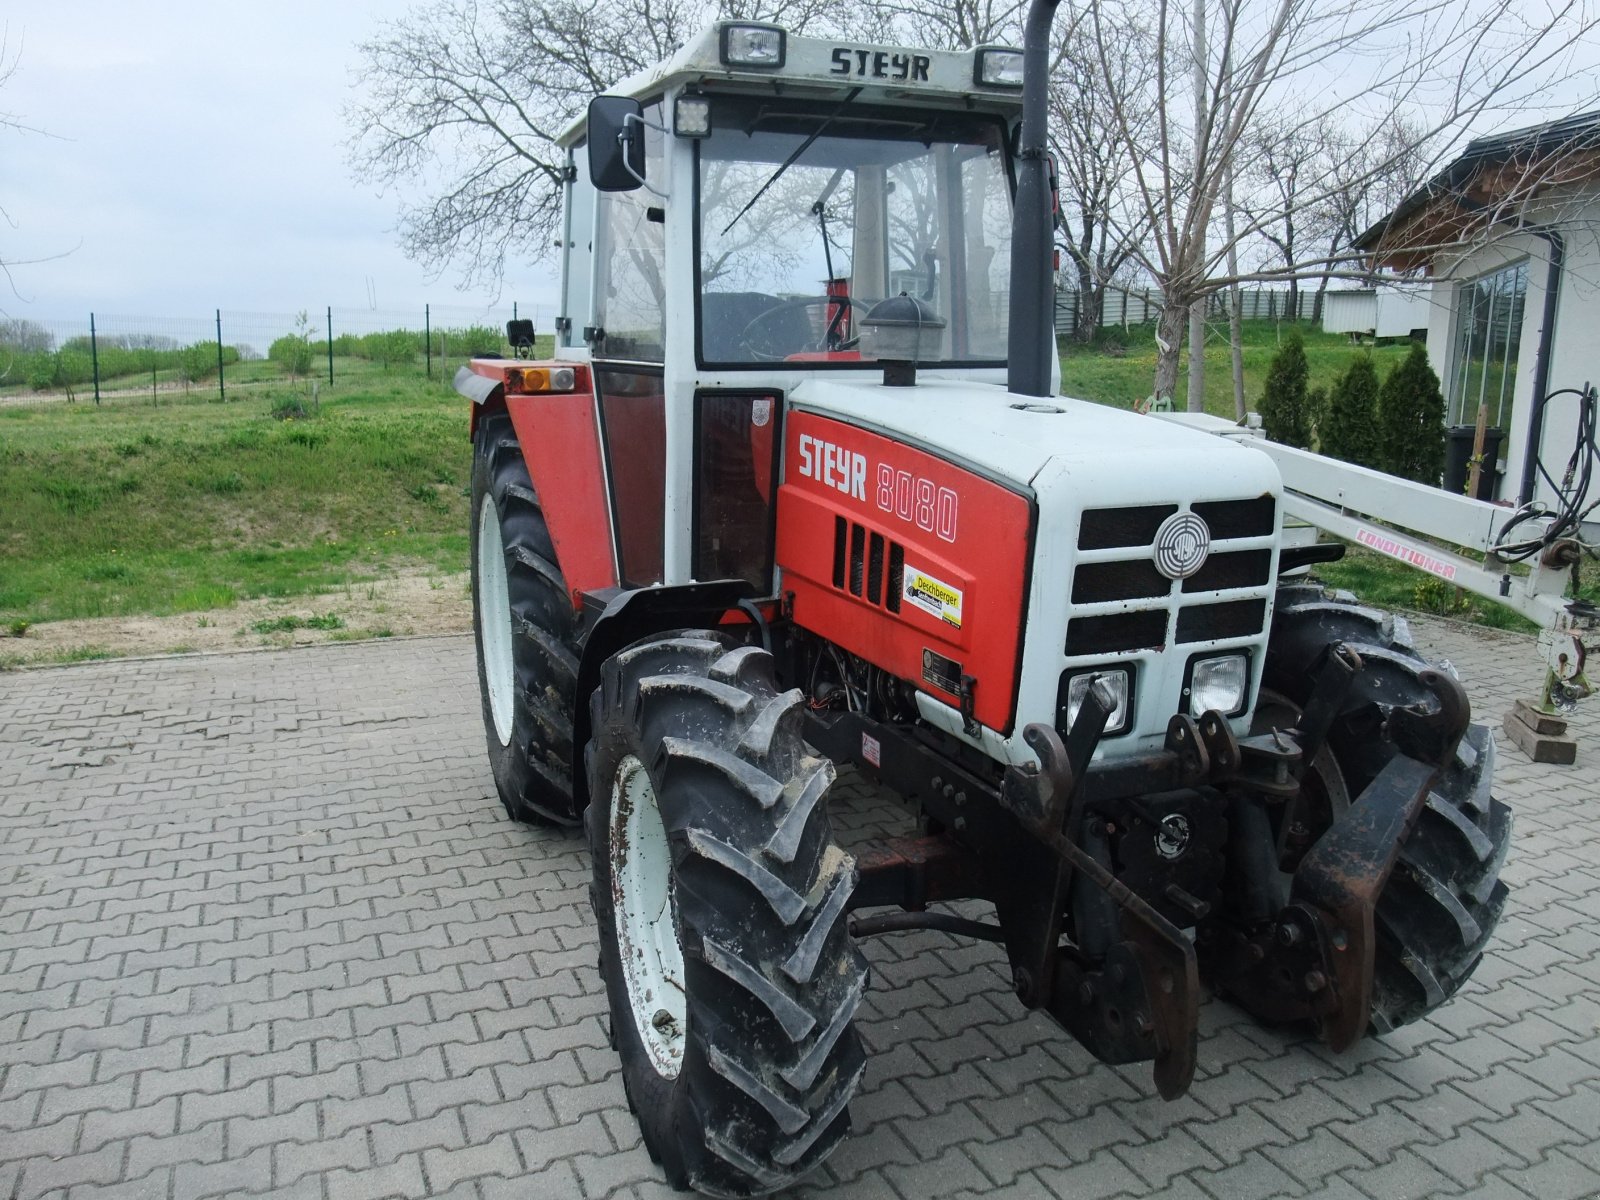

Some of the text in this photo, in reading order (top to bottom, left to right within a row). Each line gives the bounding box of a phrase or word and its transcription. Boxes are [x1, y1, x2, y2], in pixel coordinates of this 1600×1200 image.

[831, 48, 930, 81] STEYR
[799, 433, 958, 543] STEYR 8080
[1356, 529, 1455, 579] CONDITIONER
[918, 577, 957, 606] Deschberger
